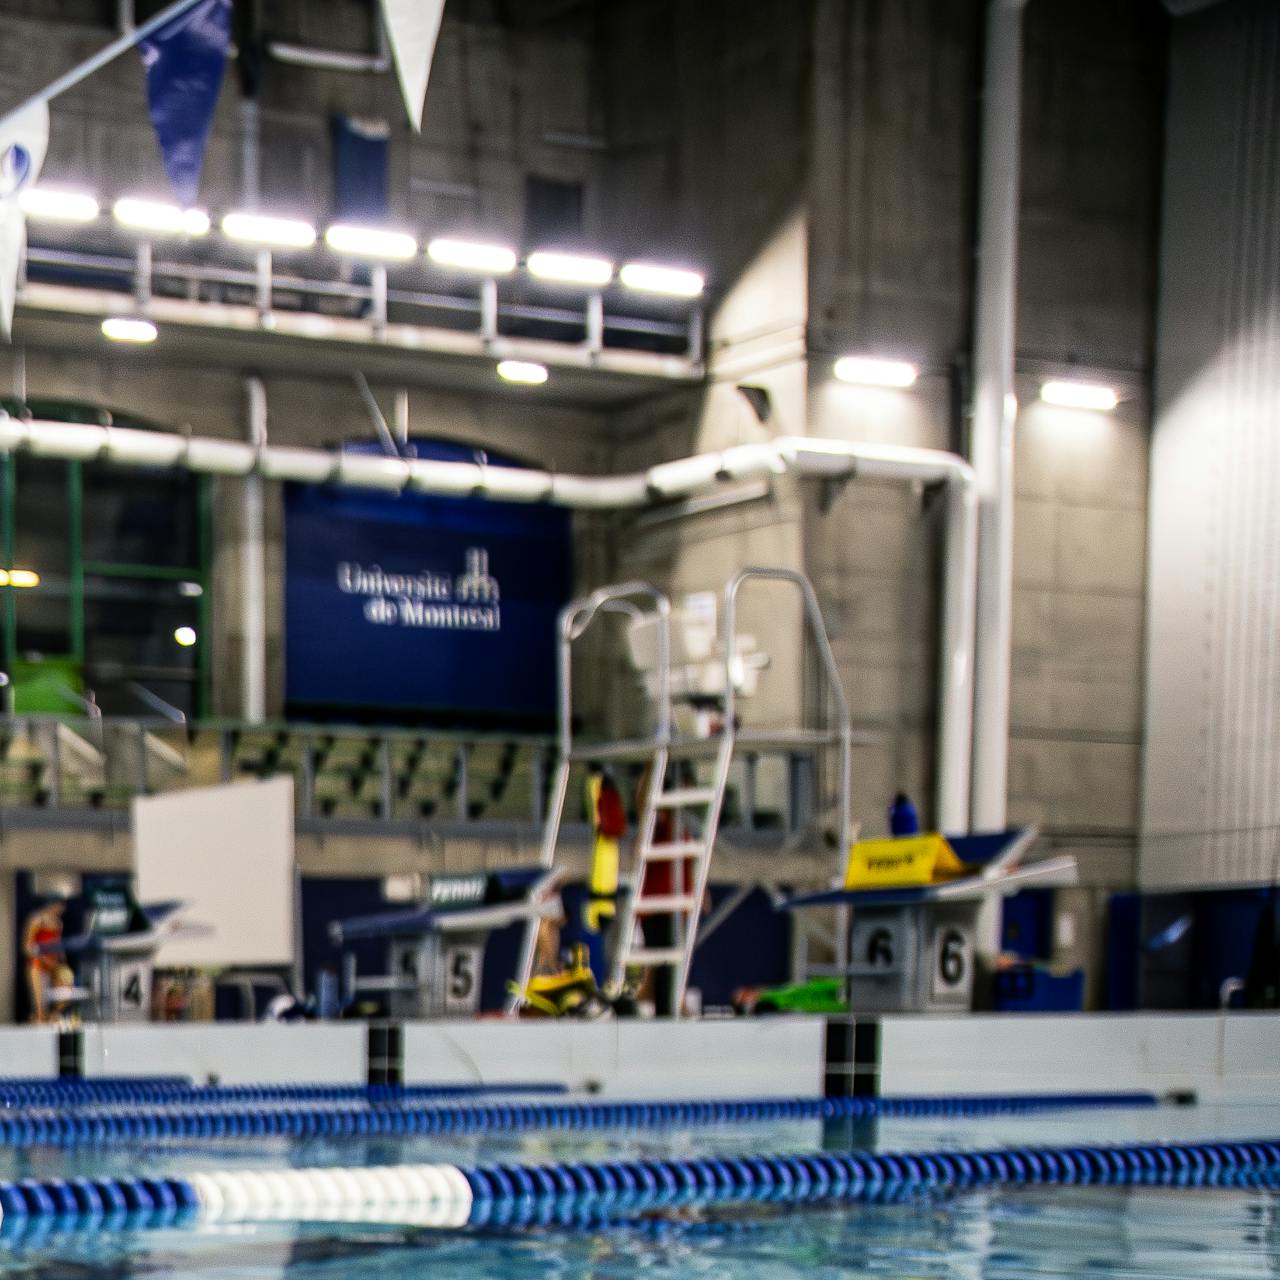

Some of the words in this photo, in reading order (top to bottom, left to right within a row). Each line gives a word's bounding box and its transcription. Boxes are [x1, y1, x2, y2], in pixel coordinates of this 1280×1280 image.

[451, 952, 474, 1000] 5
[941, 929, 965, 986] 6
[123, 973, 143, 1007] 4
